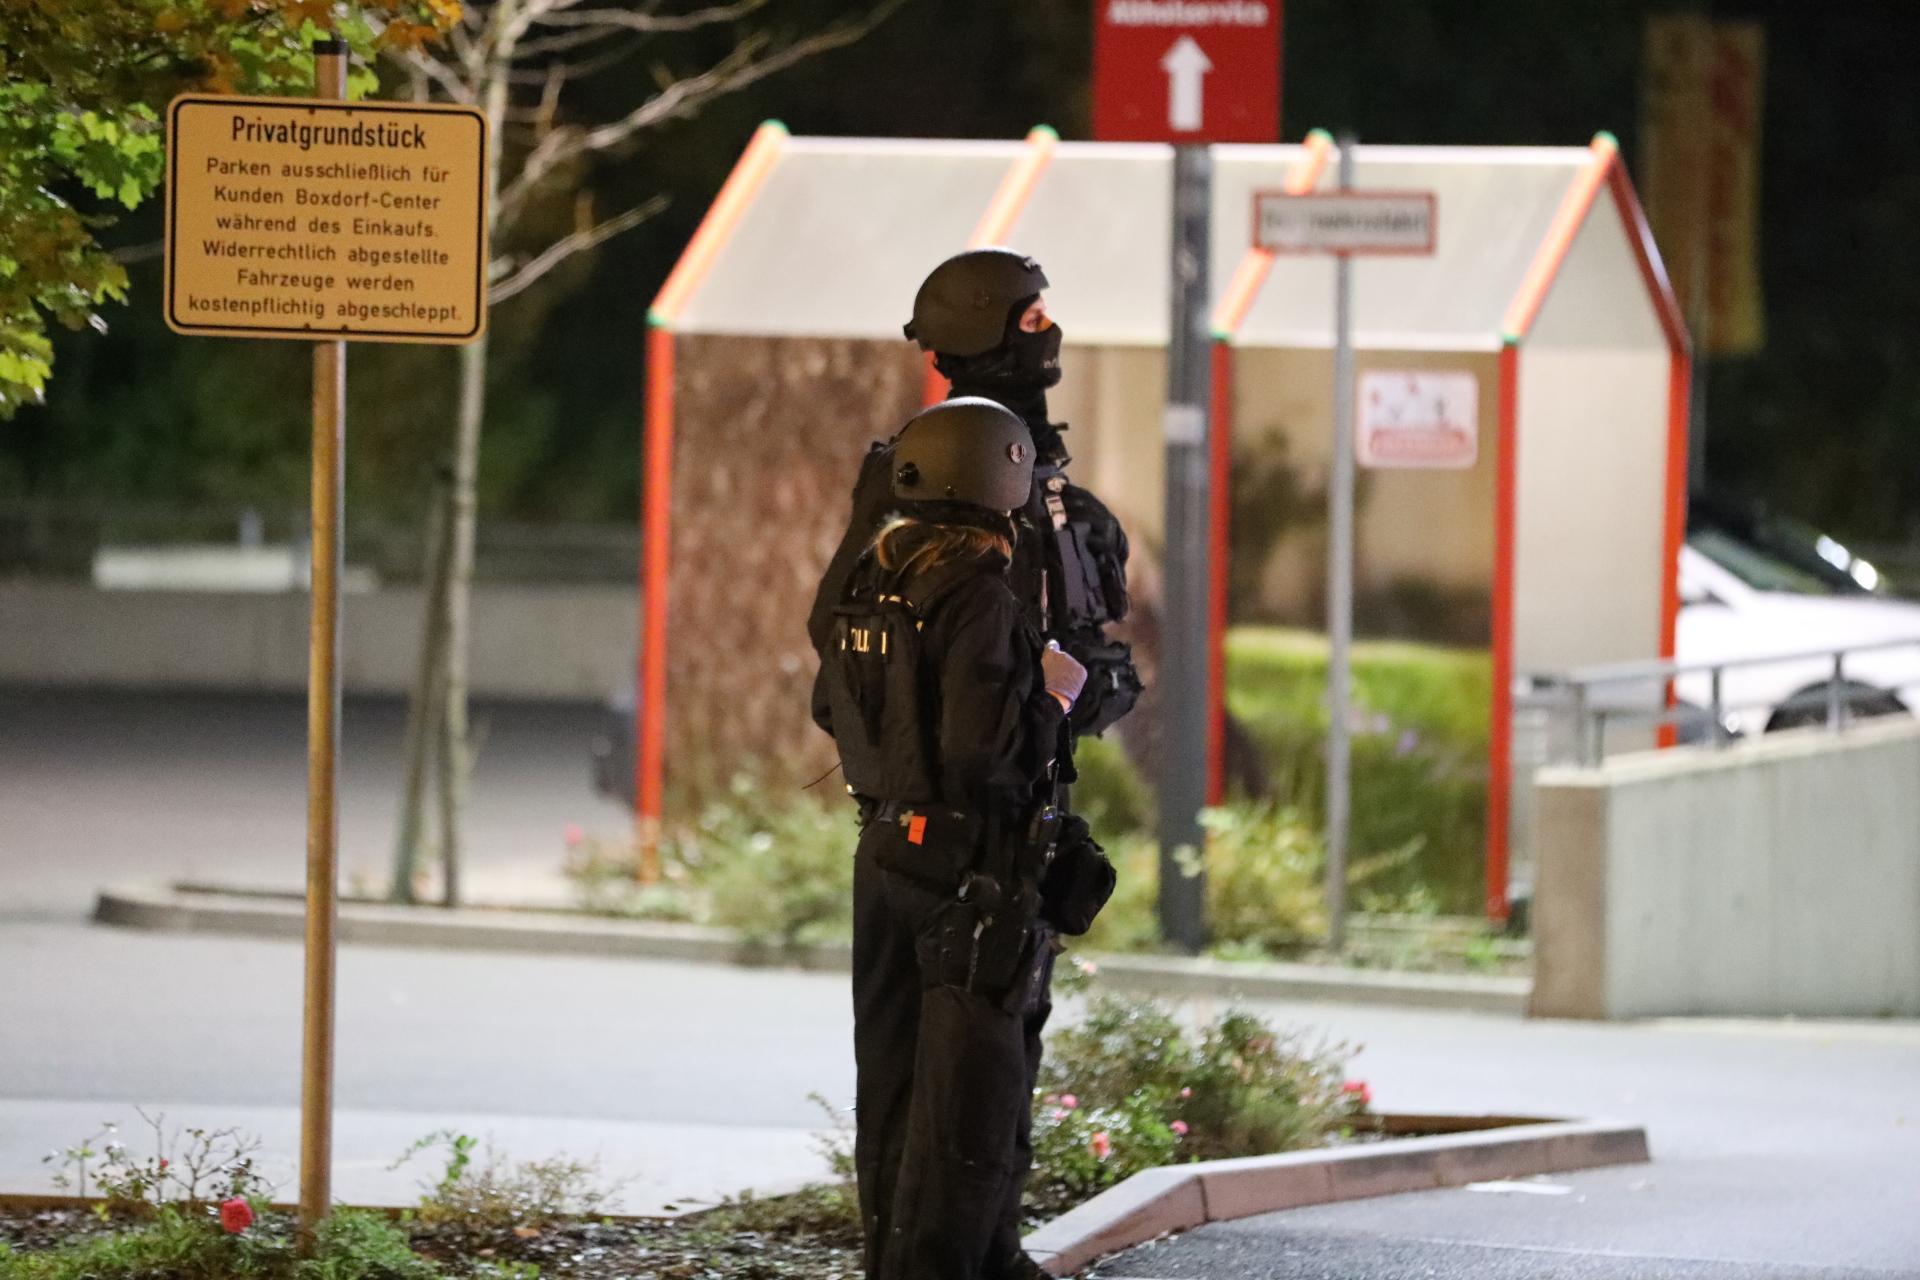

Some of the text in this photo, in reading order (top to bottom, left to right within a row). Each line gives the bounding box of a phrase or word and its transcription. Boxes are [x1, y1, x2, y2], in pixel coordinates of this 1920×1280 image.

[232, 116, 426, 150] Privatgrundstück
[206, 157, 449, 183] Parken ausschließlich für
[214, 186, 441, 210] Kunden Boxdorf-Center
[216, 215, 438, 237] während des Einkaufs.
[203, 241, 449, 267] Widerrechtlich abgestellte
[237, 269, 414, 292] Fahrzeuge werden
[189, 295, 462, 323] kostenpflichtig abgeschleppt.
